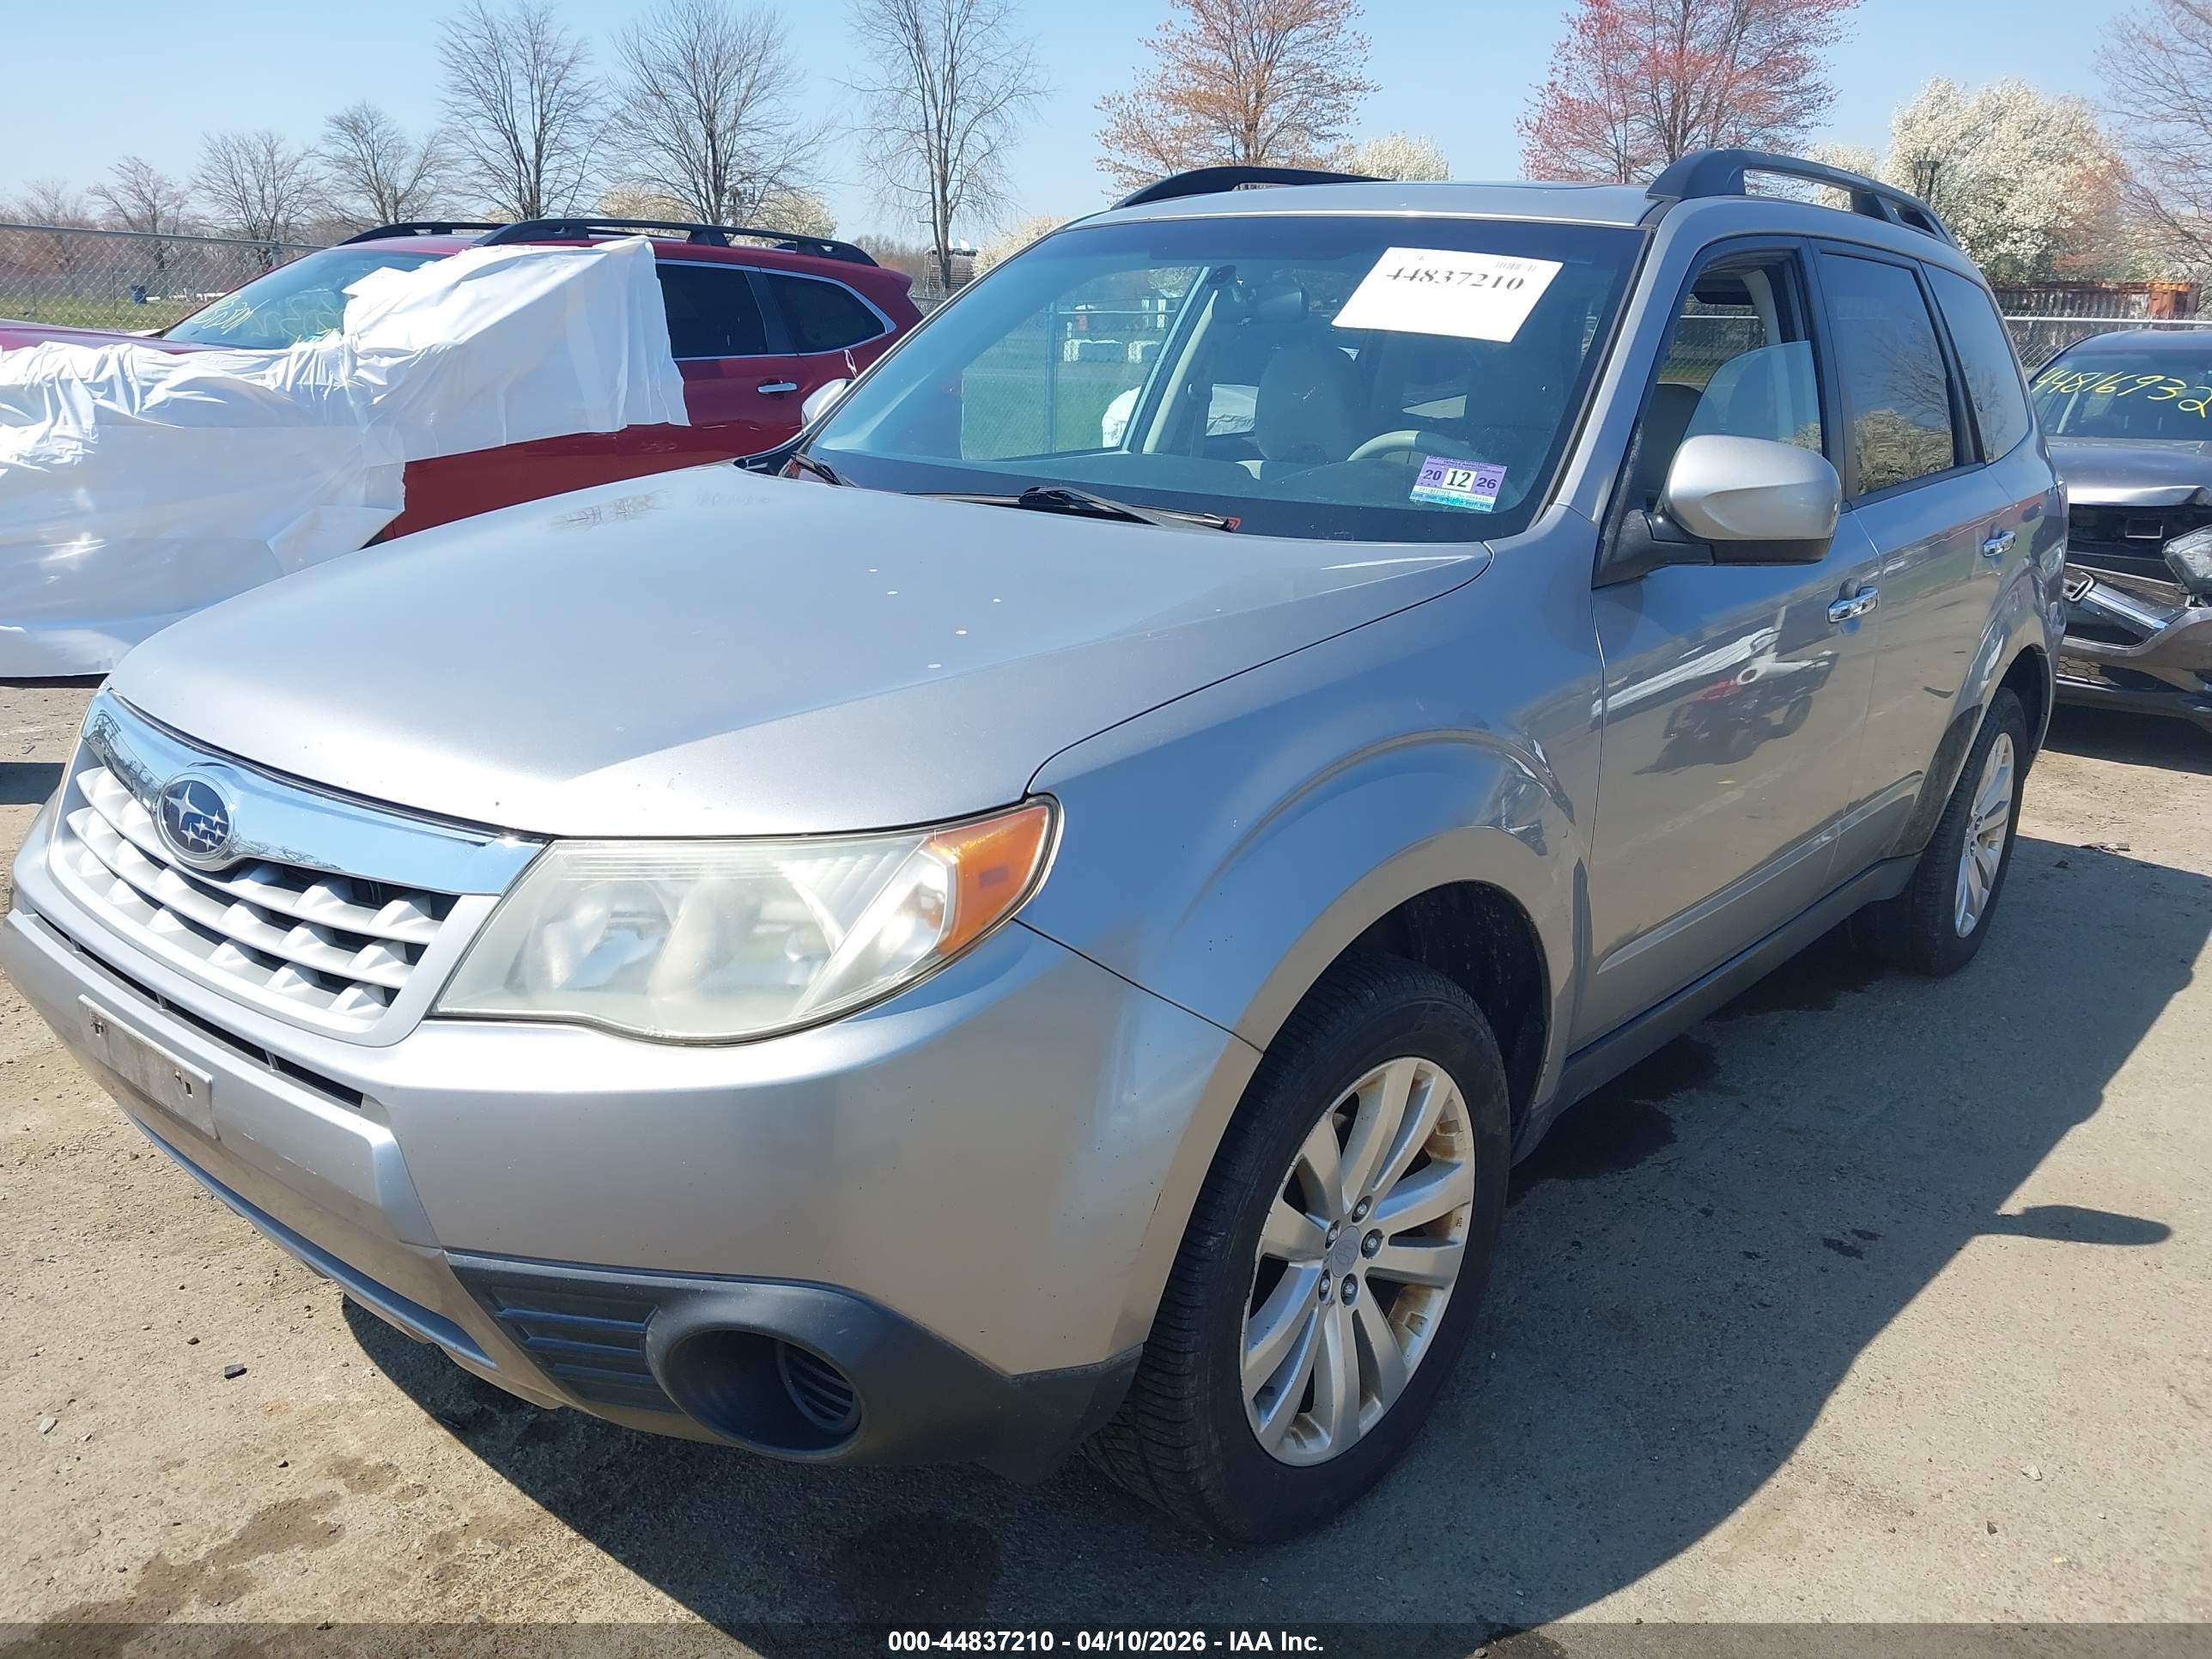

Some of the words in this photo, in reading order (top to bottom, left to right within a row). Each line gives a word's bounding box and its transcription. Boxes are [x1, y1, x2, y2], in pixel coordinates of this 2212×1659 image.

[1386, 267, 1525, 290] 44837210
[1423, 469, 1443, 481] 20
[1446, 470, 1472, 488] 12
[1476, 477, 1498, 489] 26
